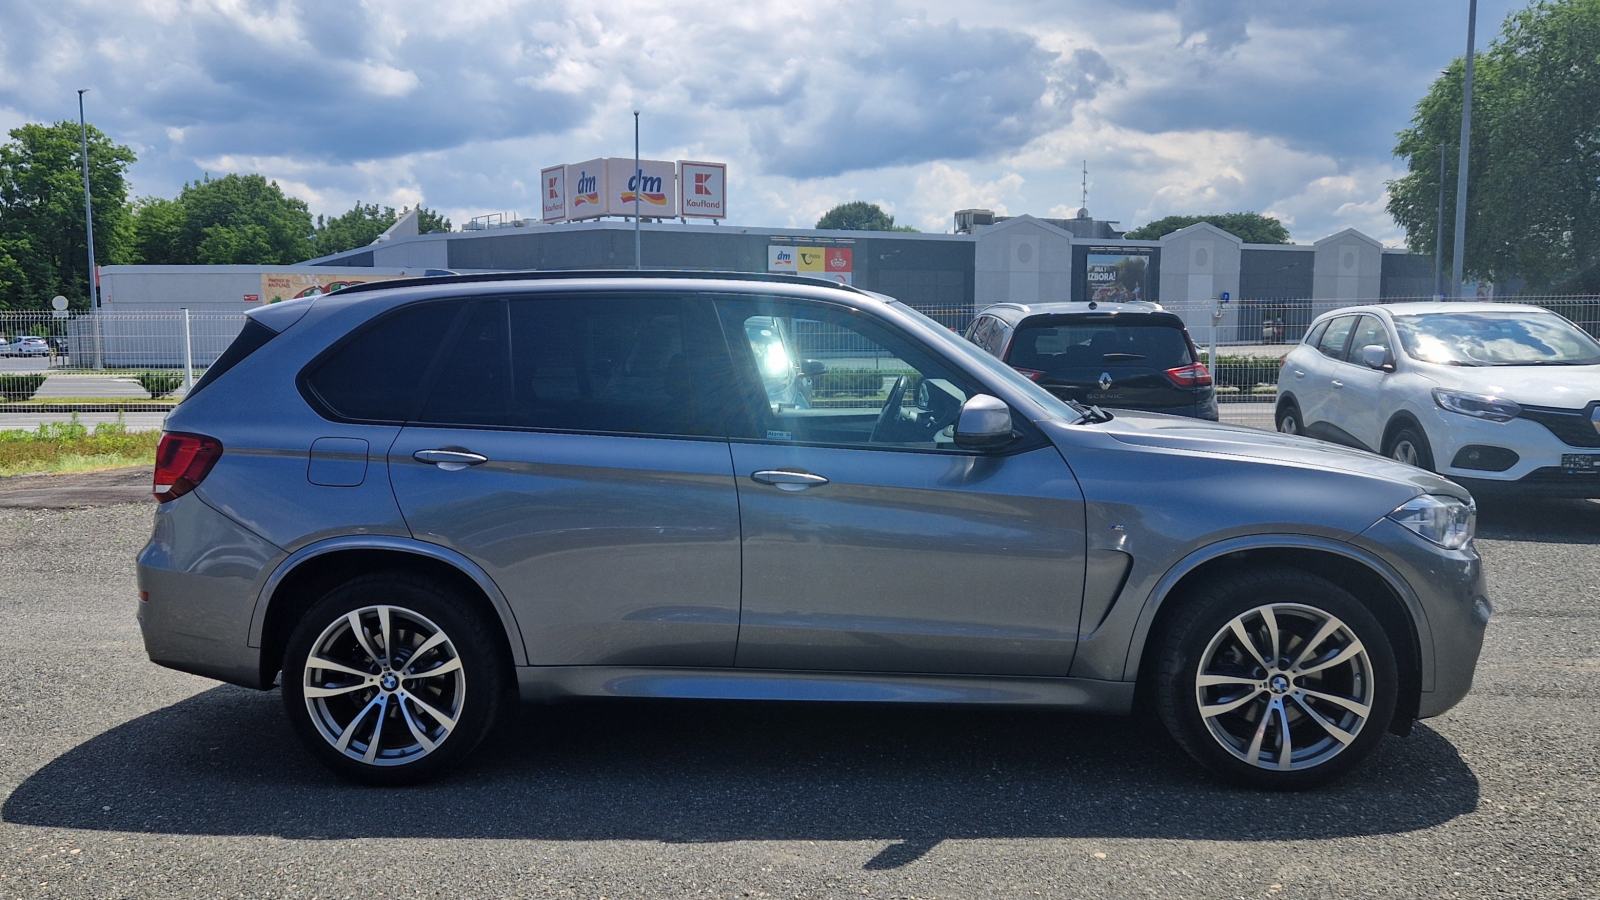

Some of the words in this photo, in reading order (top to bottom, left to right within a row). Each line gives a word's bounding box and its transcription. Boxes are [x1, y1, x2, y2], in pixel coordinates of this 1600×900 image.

[577, 171, 596, 194] dm
[628, 169, 662, 193] dm
[686, 199, 721, 209] Kaufland
[777, 250, 791, 260] dm
[1087, 271, 1116, 281] IZBORA!
